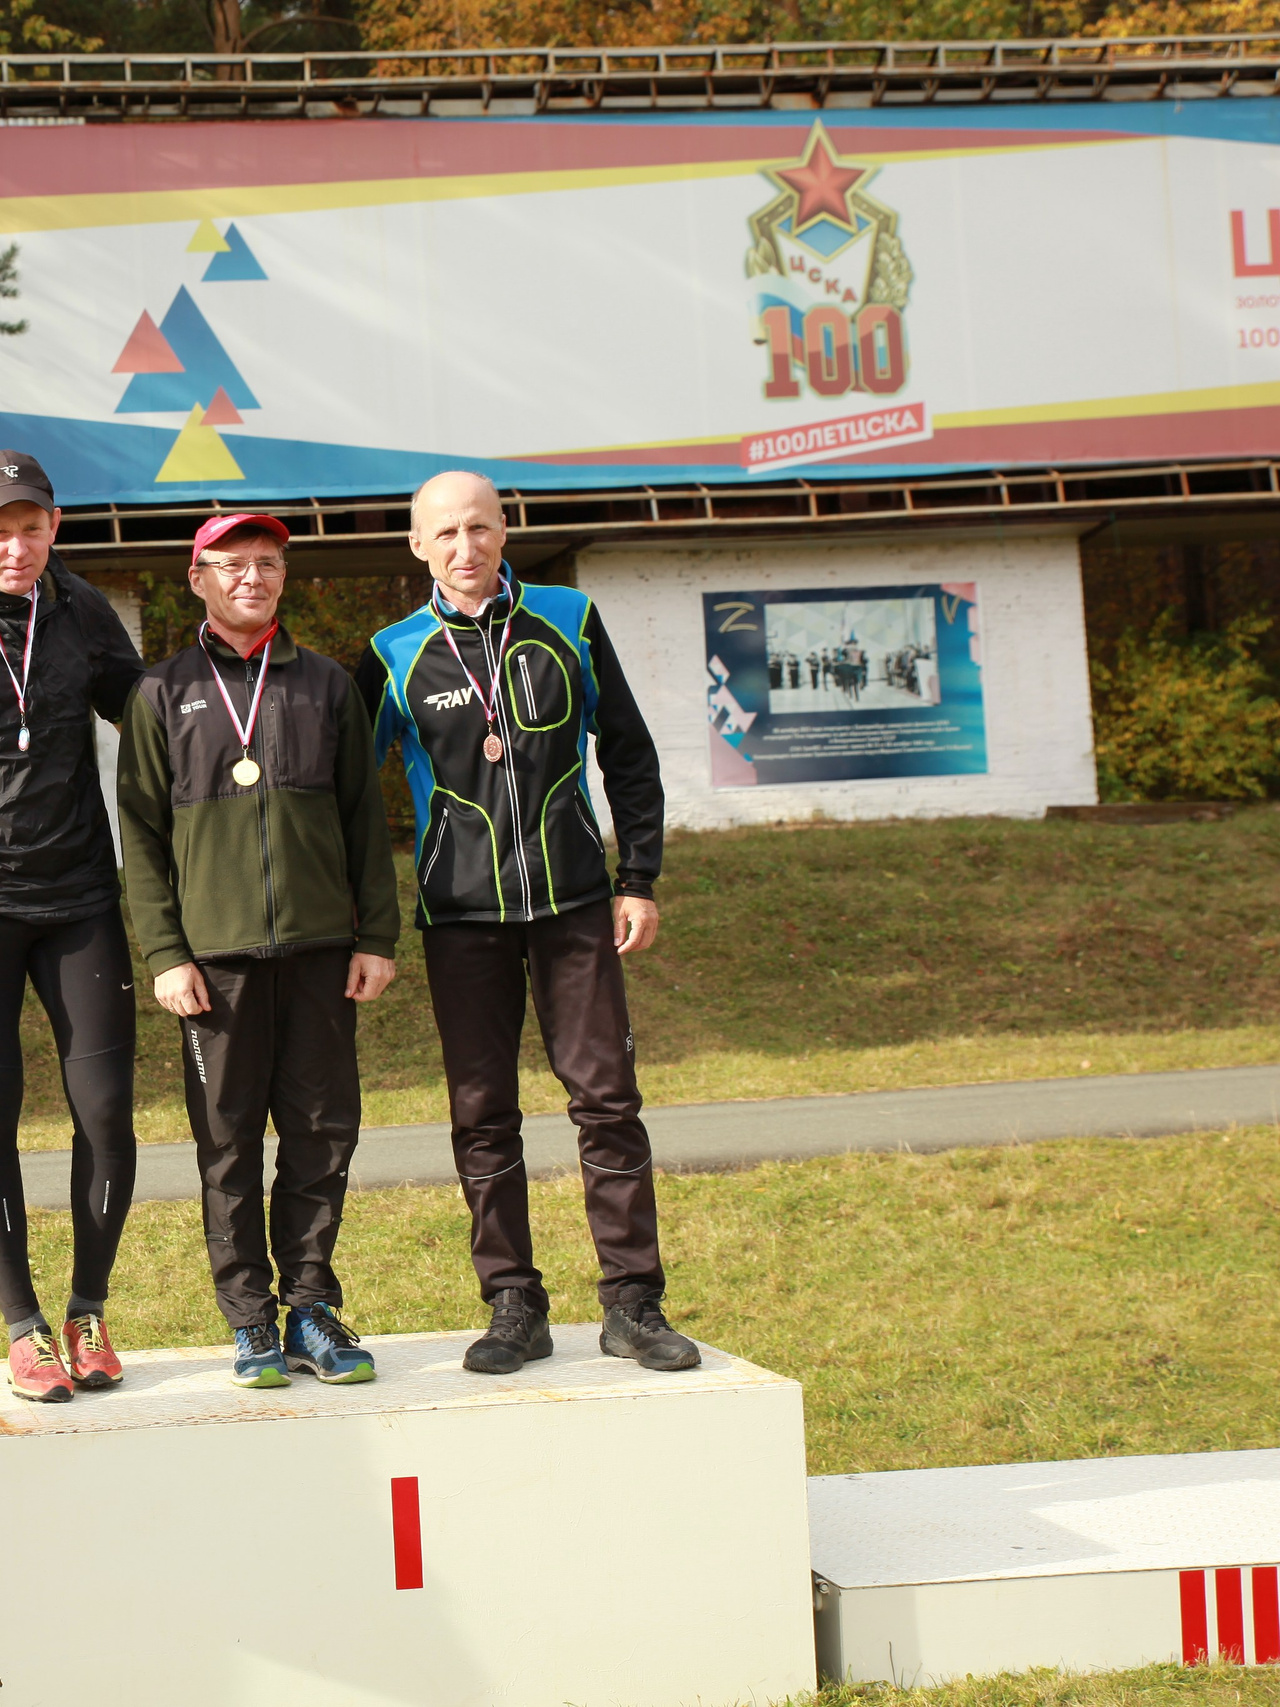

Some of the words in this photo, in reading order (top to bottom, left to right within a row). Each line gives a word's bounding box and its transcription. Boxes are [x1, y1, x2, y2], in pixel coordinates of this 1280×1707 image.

[788, 255, 858, 303] ЦСКА
[762, 305, 908, 399] 100
[748, 408, 919, 460] #100ЛЕТЦСКА
[713, 601, 758, 633] Z
[941, 595, 962, 625] V
